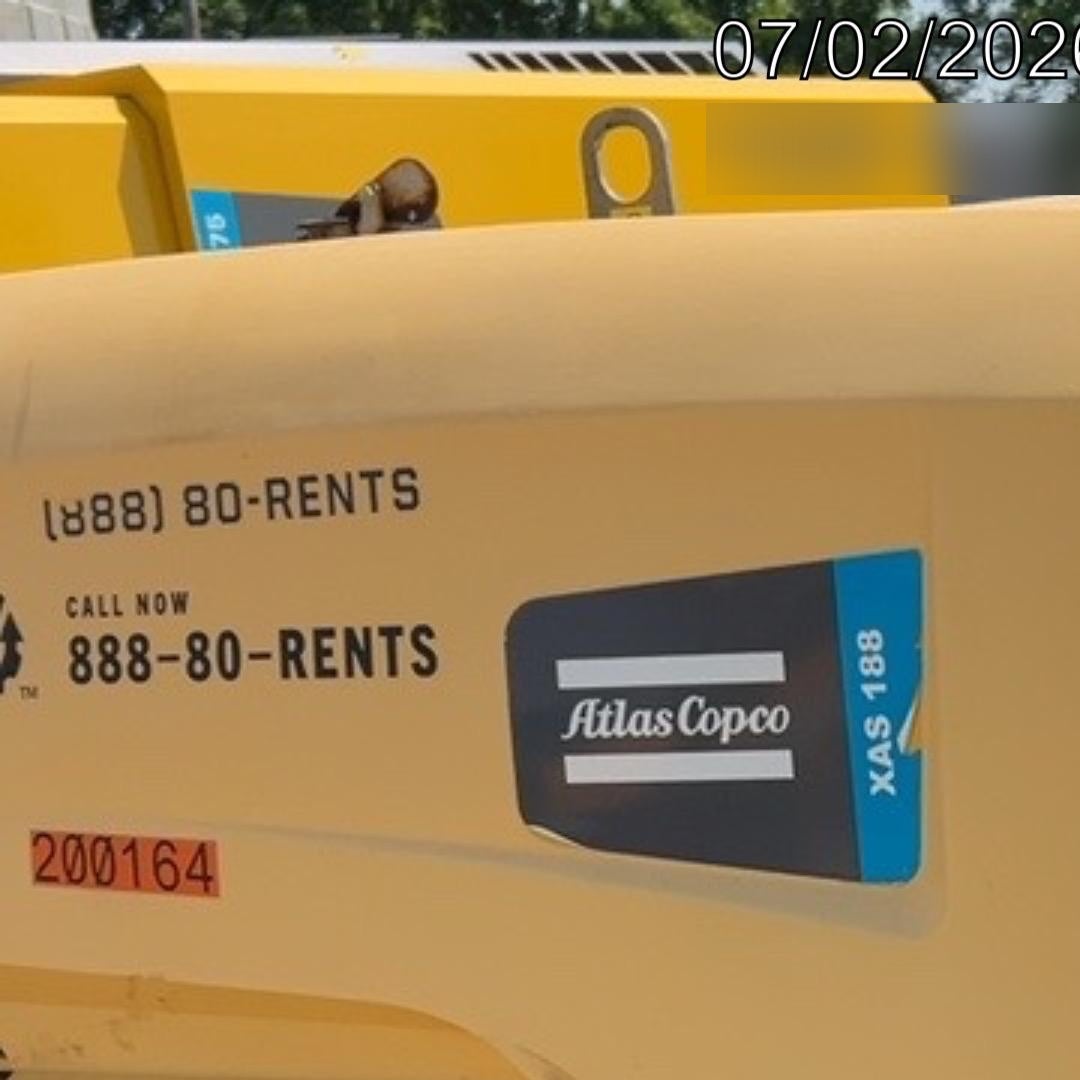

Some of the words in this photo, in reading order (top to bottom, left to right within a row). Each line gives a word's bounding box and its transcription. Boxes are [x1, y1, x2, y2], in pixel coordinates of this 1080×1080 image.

[182, 467, 420, 527] 80-RENTS
[66, 594, 124, 619] CALL
[136, 591, 189, 616] NOW
[69, 623, 438, 685] 888-80-RENTS
[857, 628, 888, 700] 188
[864, 714, 897, 796] XAS
[31, 831, 215, 893] 200164
